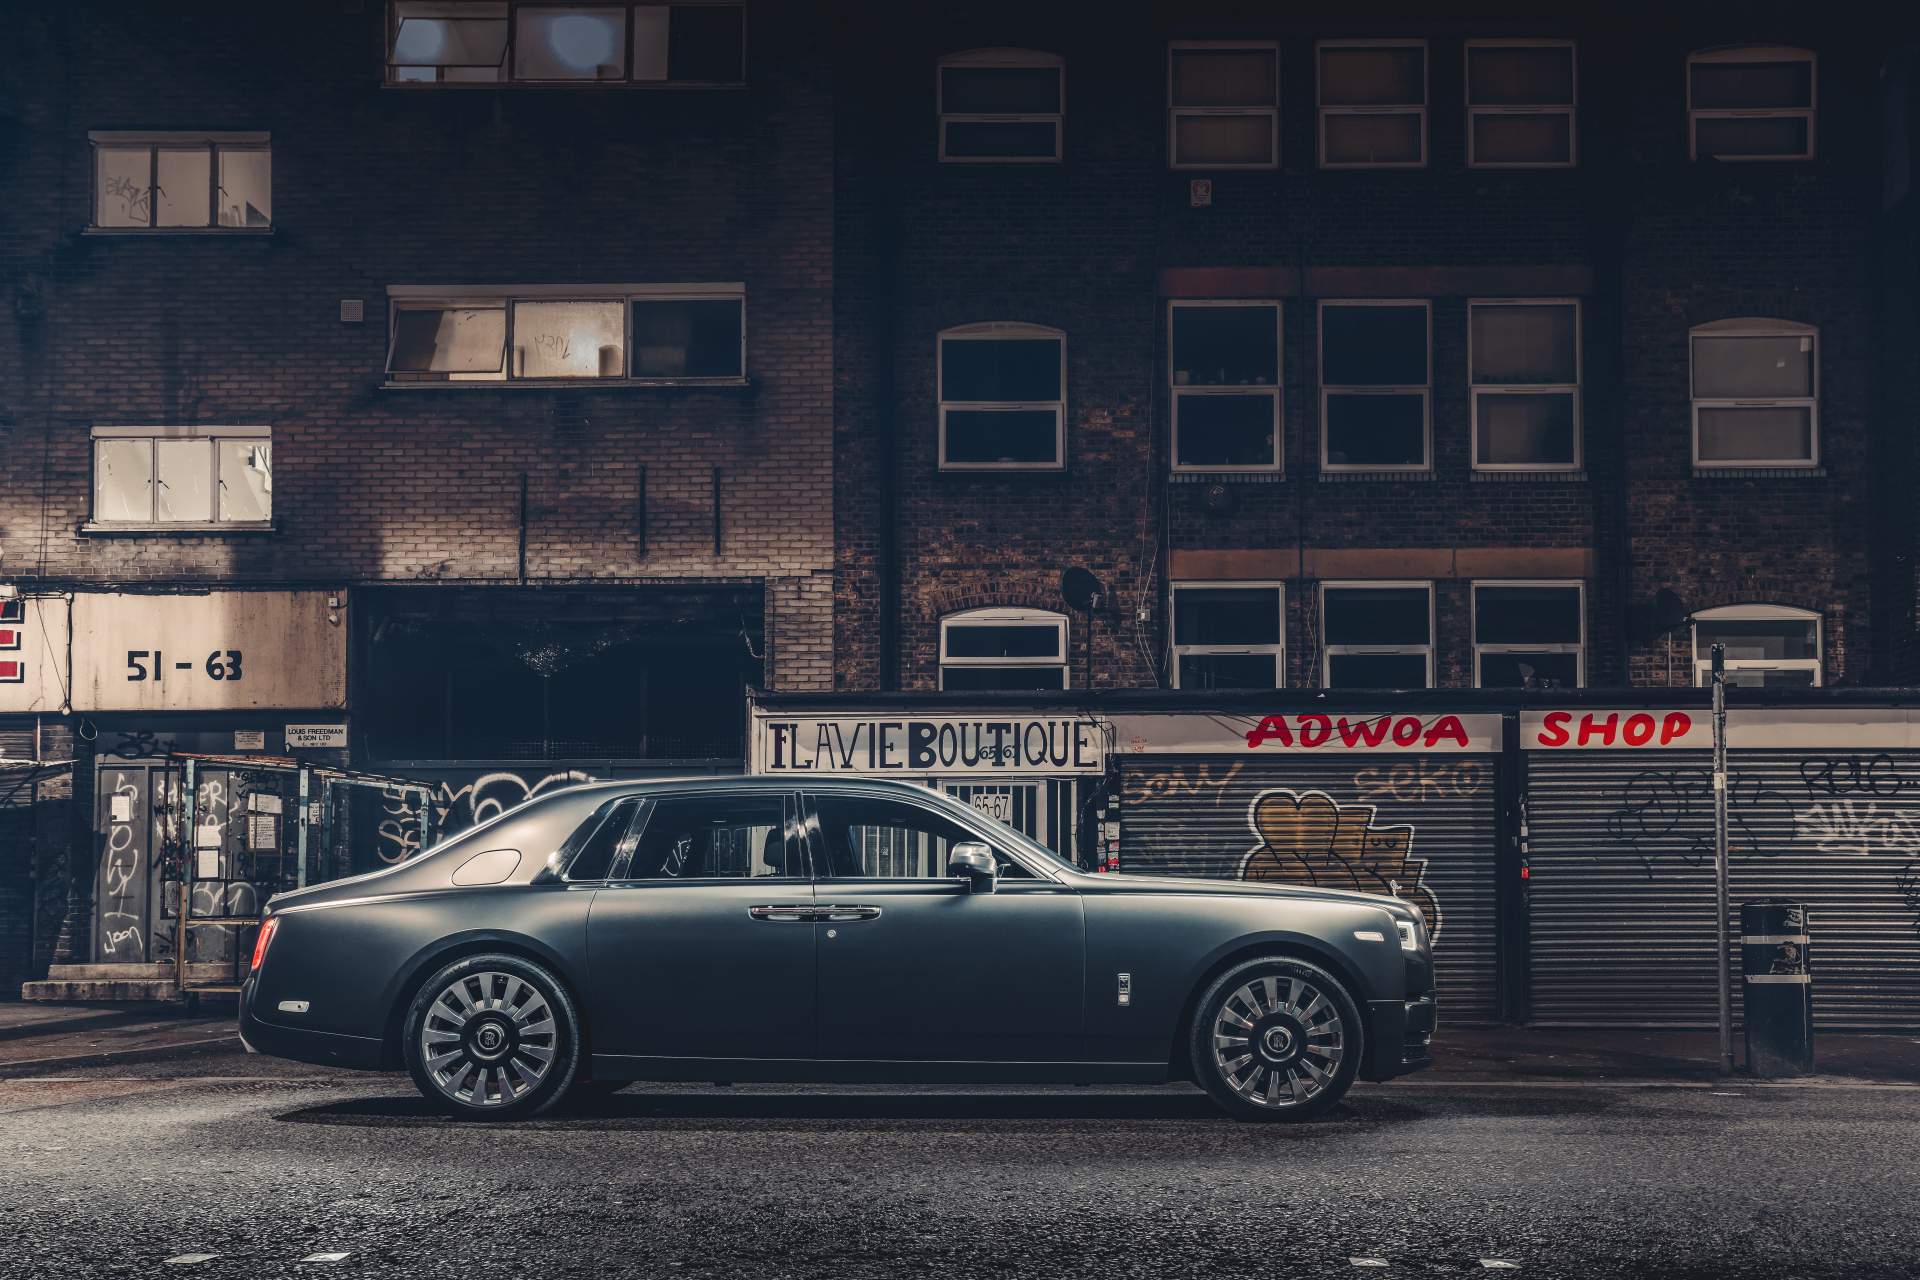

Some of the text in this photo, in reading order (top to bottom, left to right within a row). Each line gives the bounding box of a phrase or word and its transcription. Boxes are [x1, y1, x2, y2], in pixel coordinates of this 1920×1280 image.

[128, 651, 161, 681] 51
[206, 651, 242, 681] 63
[769, 721, 1098, 769] FLAVIE BOUTIQUE
[1247, 714, 1469, 748] ADWOA
[1538, 712, 1691, 747] SHOP
[975, 796, 1009, 819] 65-67
